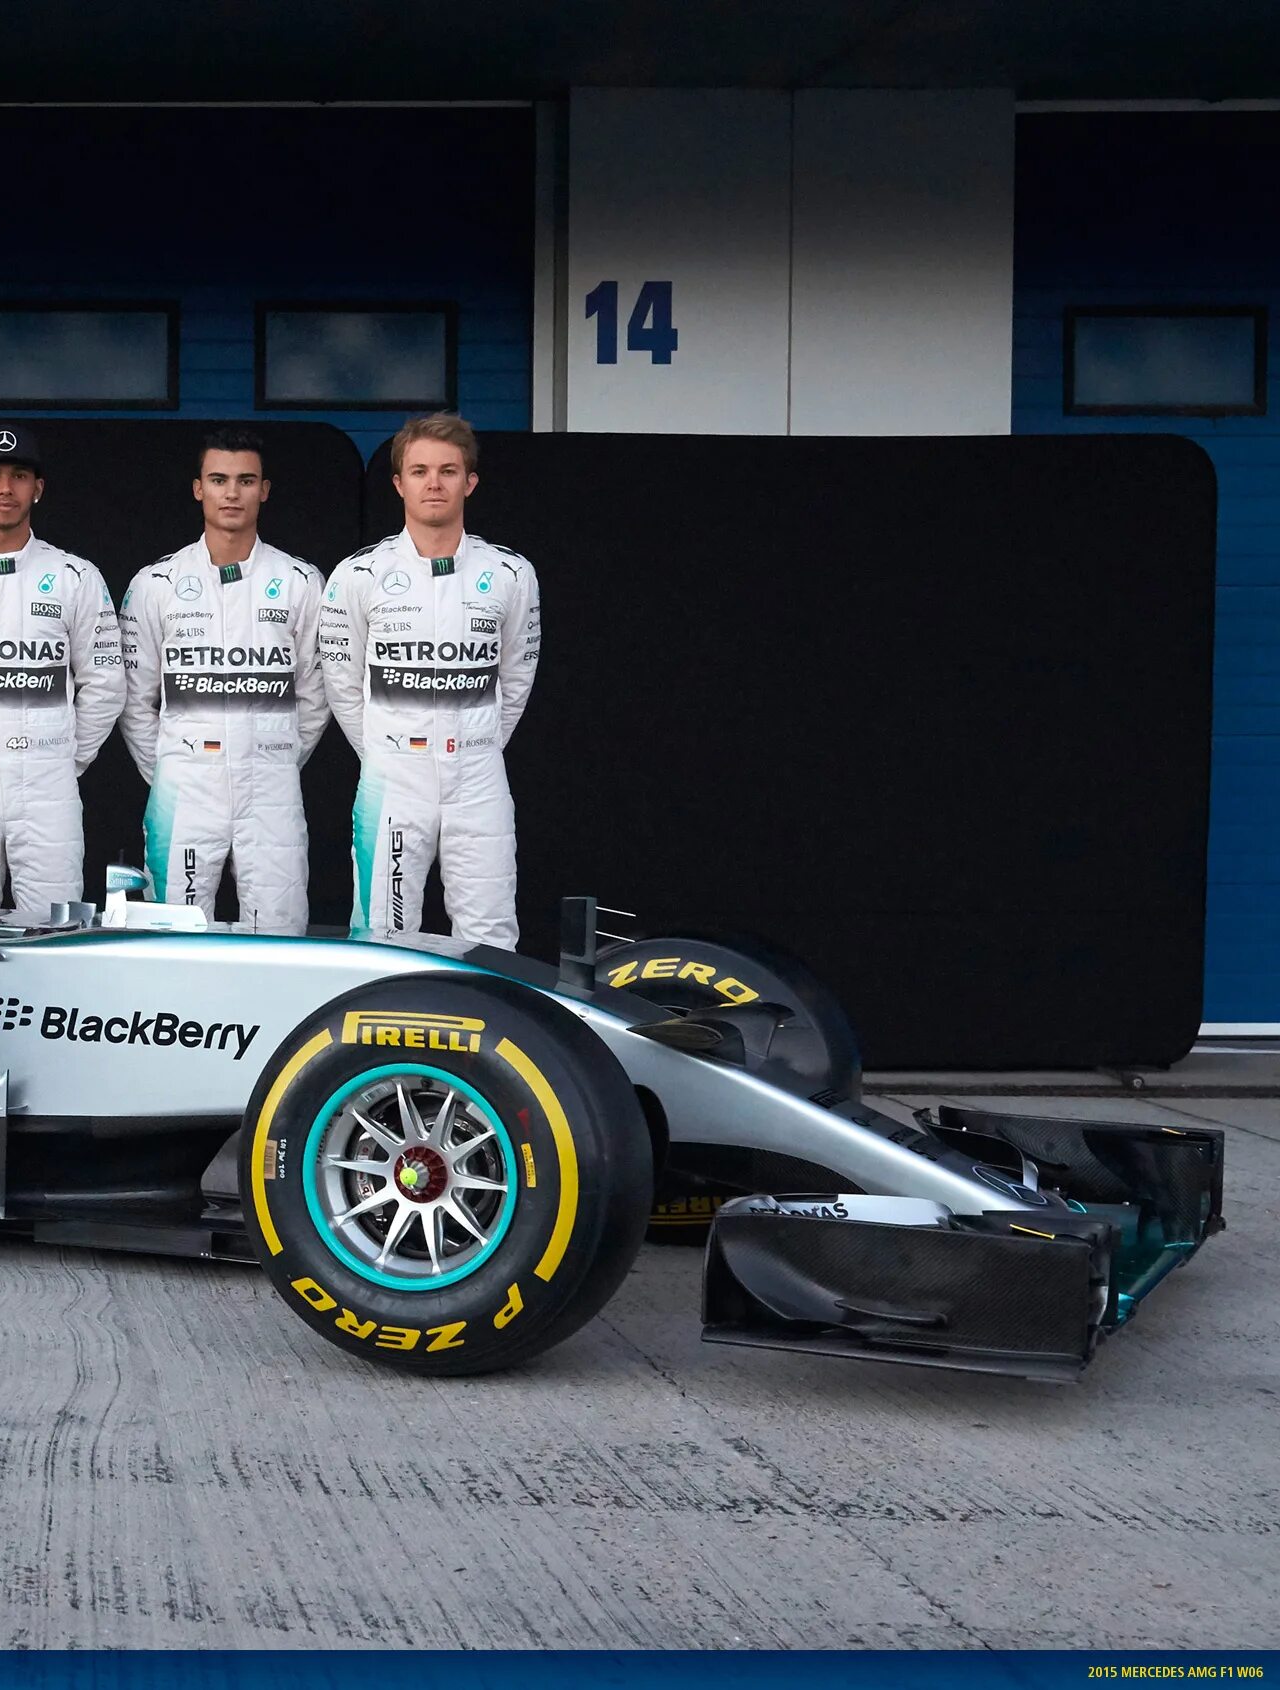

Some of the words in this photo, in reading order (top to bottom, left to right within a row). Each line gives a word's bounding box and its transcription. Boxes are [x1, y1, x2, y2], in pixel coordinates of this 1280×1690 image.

[585, 281, 678, 364] 14
[32, 603, 61, 614] BOSS
[175, 611, 214, 621] BlackBerry
[259, 609, 289, 620] BOSS
[381, 605, 422, 614] BlackBerry
[393, 622, 412, 632] UBS
[472, 619, 497, 629] BOSS
[186, 628, 205, 638] UBS
[94, 641, 118, 649] Allianz
[375, 641, 498, 661] PETRONAS
[94, 655, 122, 666] EPSO
[166, 646, 292, 667] PETRONAS
[196, 676, 290, 697] BlackBerry
[402, 672, 492, 691] BlackBerry
[6, 736, 28, 750] 44
[446, 738, 455, 753] 6
[607, 958, 760, 1004] ZERO
[40, 1006, 260, 1060] BlackBerry
[341, 1011, 486, 1053] PIRELLI
[493, 1282, 525, 1330] P
[291, 1277, 468, 1353] ZERO
